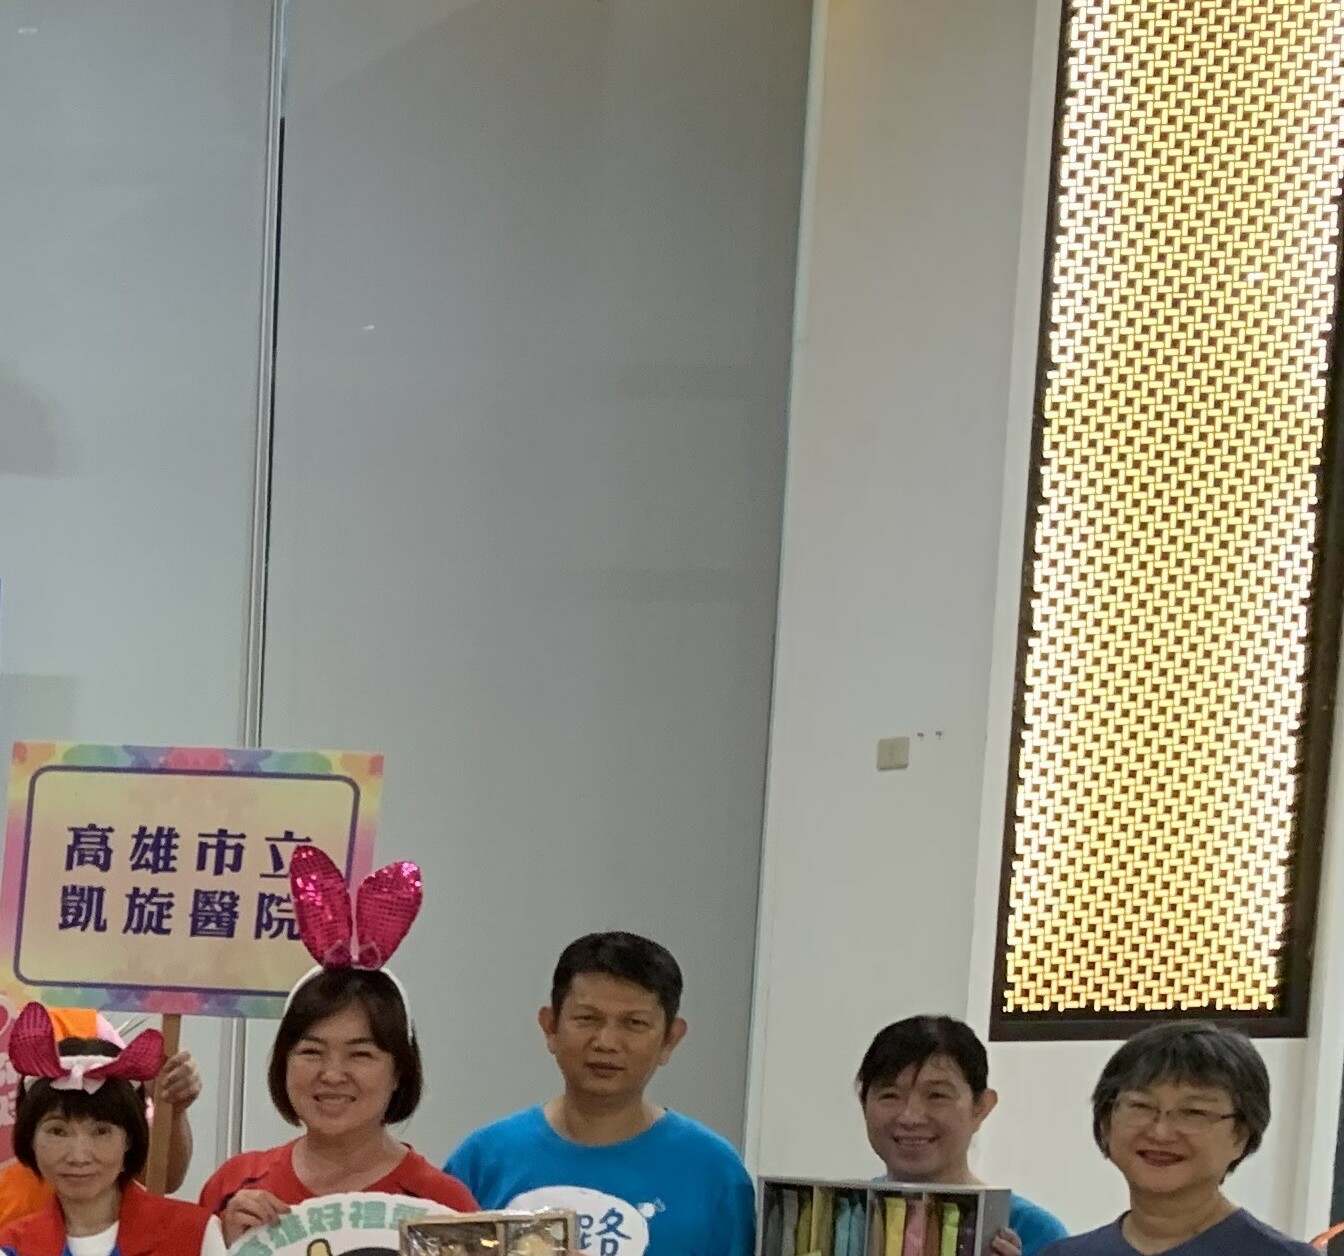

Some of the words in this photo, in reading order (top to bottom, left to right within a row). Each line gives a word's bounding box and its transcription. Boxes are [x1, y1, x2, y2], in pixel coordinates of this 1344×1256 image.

[65, 823, 312, 879] 高雄市立
[58, 885, 302, 940] 凱旋醫院
